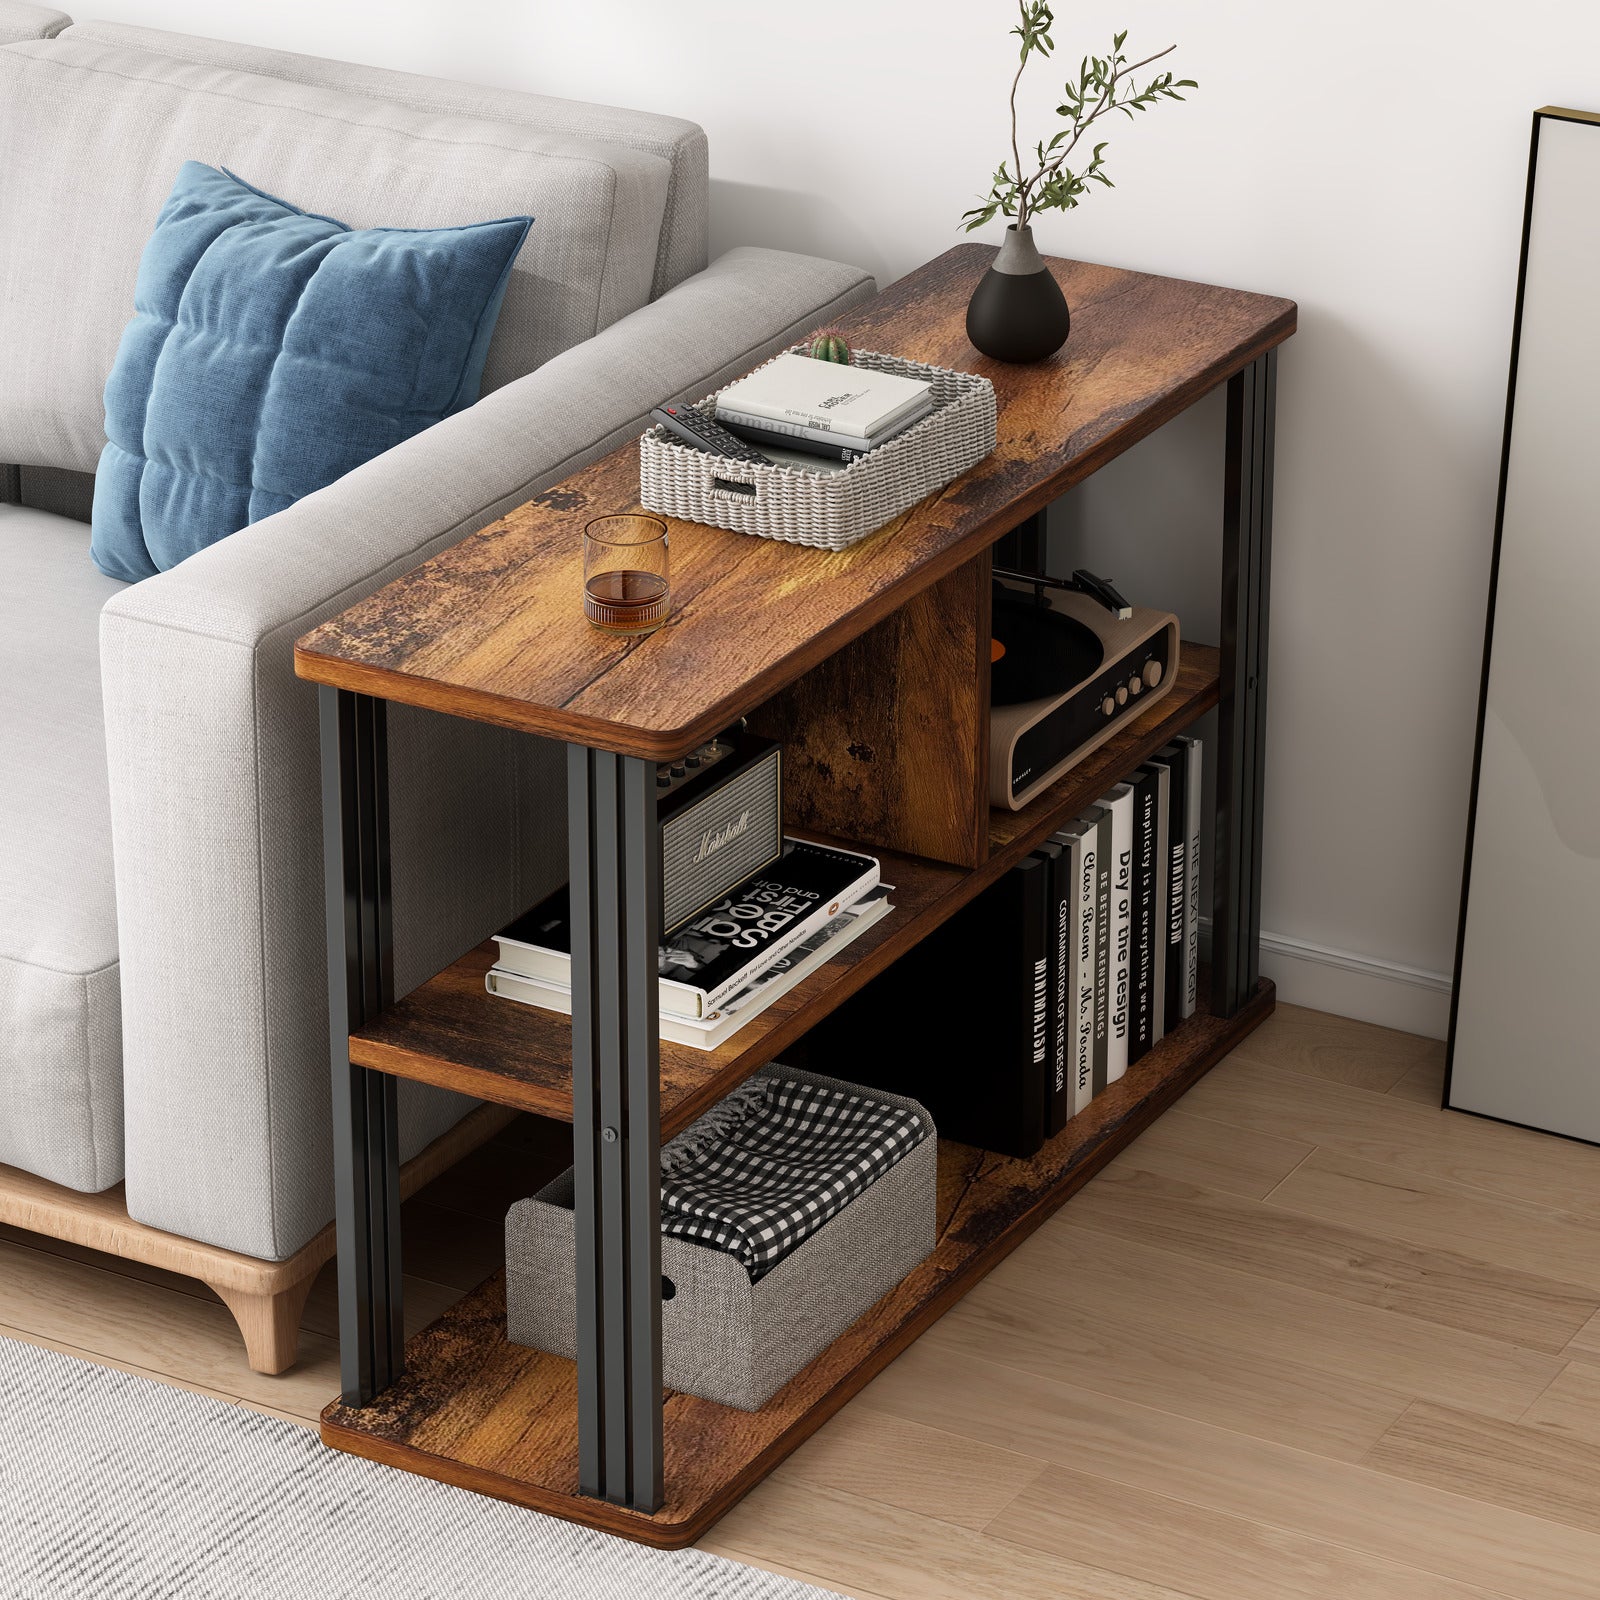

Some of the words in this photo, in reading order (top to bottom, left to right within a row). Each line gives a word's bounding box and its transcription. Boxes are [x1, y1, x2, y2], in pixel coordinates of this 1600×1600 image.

[716, 410, 809, 440] Romanik
[692, 810, 750, 863] Marshall
[1142, 793, 1153, 867] simplicity
[1192, 830, 1200, 870] THE
[1083, 852, 1095, 902] Class
[1100, 871, 1108, 888] BE
[1115, 850, 1131, 890] Day
[1143, 872, 1151, 886] is
[742, 888, 813, 916] First
[783, 886, 820, 900] and
[1118, 899, 1129, 919] of
[1142, 890, 1151, 905] in
[1171, 842, 1184, 944] MINIMALISM
[1190, 874, 1199, 923] NEXT
[1081, 906, 1094, 962] Room
[1099, 893, 1107, 945] BETTER
[1058, 899, 1067, 1002] CONTAMINATION
[1117, 925, 1129, 962] the
[1139, 910, 1149, 989] everything
[1187, 931, 1197, 1004] DESIGN
[707, 987, 728, 1008] Samuel
[728, 972, 748, 992] Beckett
[1034, 957, 1047, 1063] MINIMALISM
[1057, 1002, 1065, 1019] OF
[1097, 950, 1107, 1040] RENDERINGS
[1112, 968, 1128, 1039] design
[1140, 992, 1147, 1013] we
[1056, 1021, 1065, 1046] THE
[1055, 1046, 1064, 1092] DESIGN
